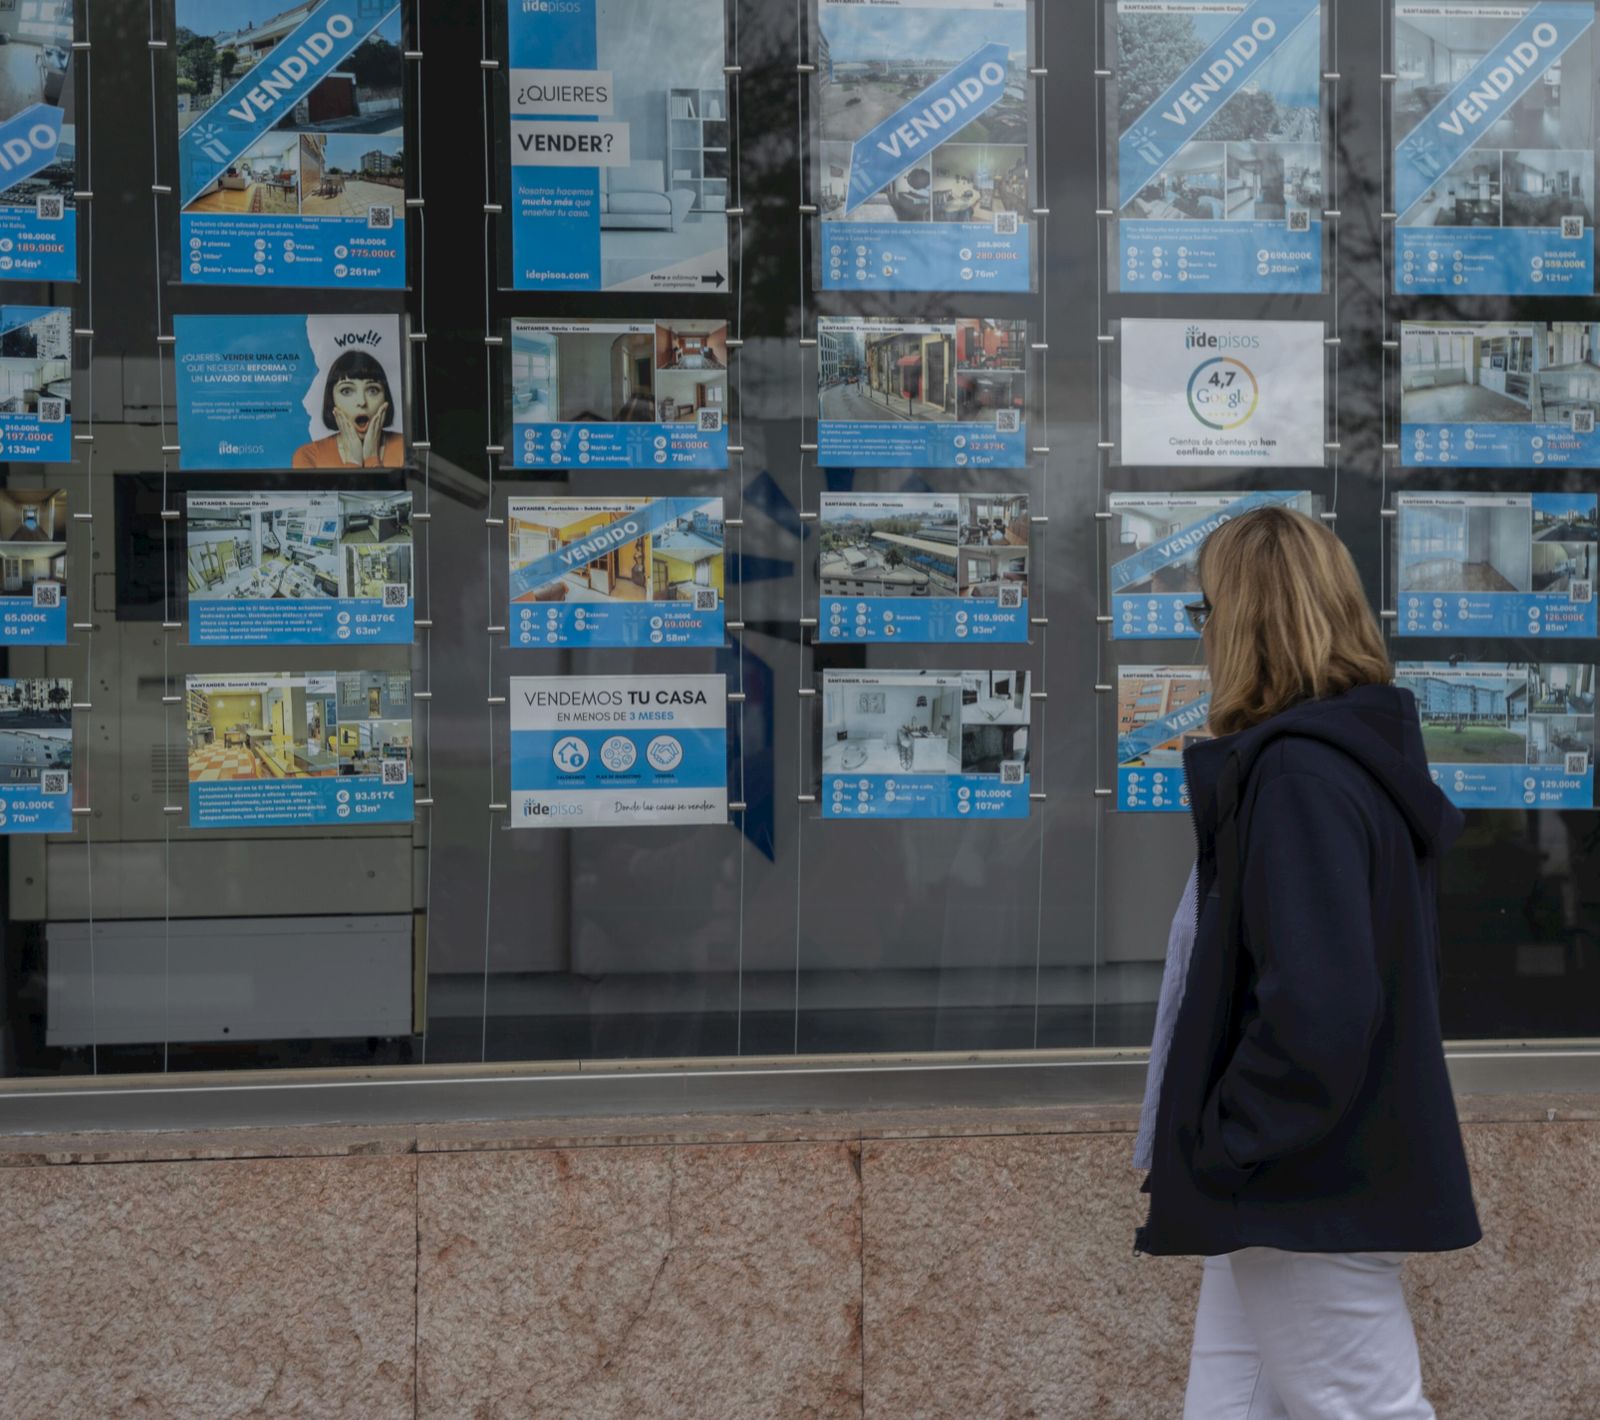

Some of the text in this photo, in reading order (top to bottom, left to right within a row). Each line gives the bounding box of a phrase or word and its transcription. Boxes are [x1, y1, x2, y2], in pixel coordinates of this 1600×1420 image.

[228, 14, 354, 124] VENDIDO
[1162, 16, 1276, 126] VENDIDO
[1438, 22, 1558, 136] VENDIDO
[518, 86, 608, 104] ¿QUIERES
[877, 62, 1004, 158] VENDIDO
[518, 134, 614, 152] VENDER?
[519, 187, 594, 196] Nosotros hacemos
[554, 198, 573, 206] más
[574, 200, 591, 208] que
[522, 208, 556, 216] enseñar
[350, 250, 396, 258] 775.000€
[526, 270, 588, 281] idepisos.com
[334, 330, 382, 347] WOW!!!
[182, 354, 220, 362] ¿QUIERES
[1208, 372, 1236, 388] 4,7
[1169, 438, 1276, 448] Cientos de clientes ya han
[1176, 448, 1215, 456] confiado
[1159, 514, 1232, 558] VENDIDO
[560, 521, 638, 566] VENDIDO
[4, 614, 48, 622] 65.000€
[524, 690, 707, 706] VENDEMOS TU CASA
[558, 712, 674, 722] EN MENOS DE 3 MESES
[12, 801, 54, 810] 69.000€
[524, 804, 584, 818] idepisos
[614, 802, 640, 812] Donde
[642, 802, 654, 811] las
[678, 804, 686, 812] se
[688, 801, 716, 811] venden
